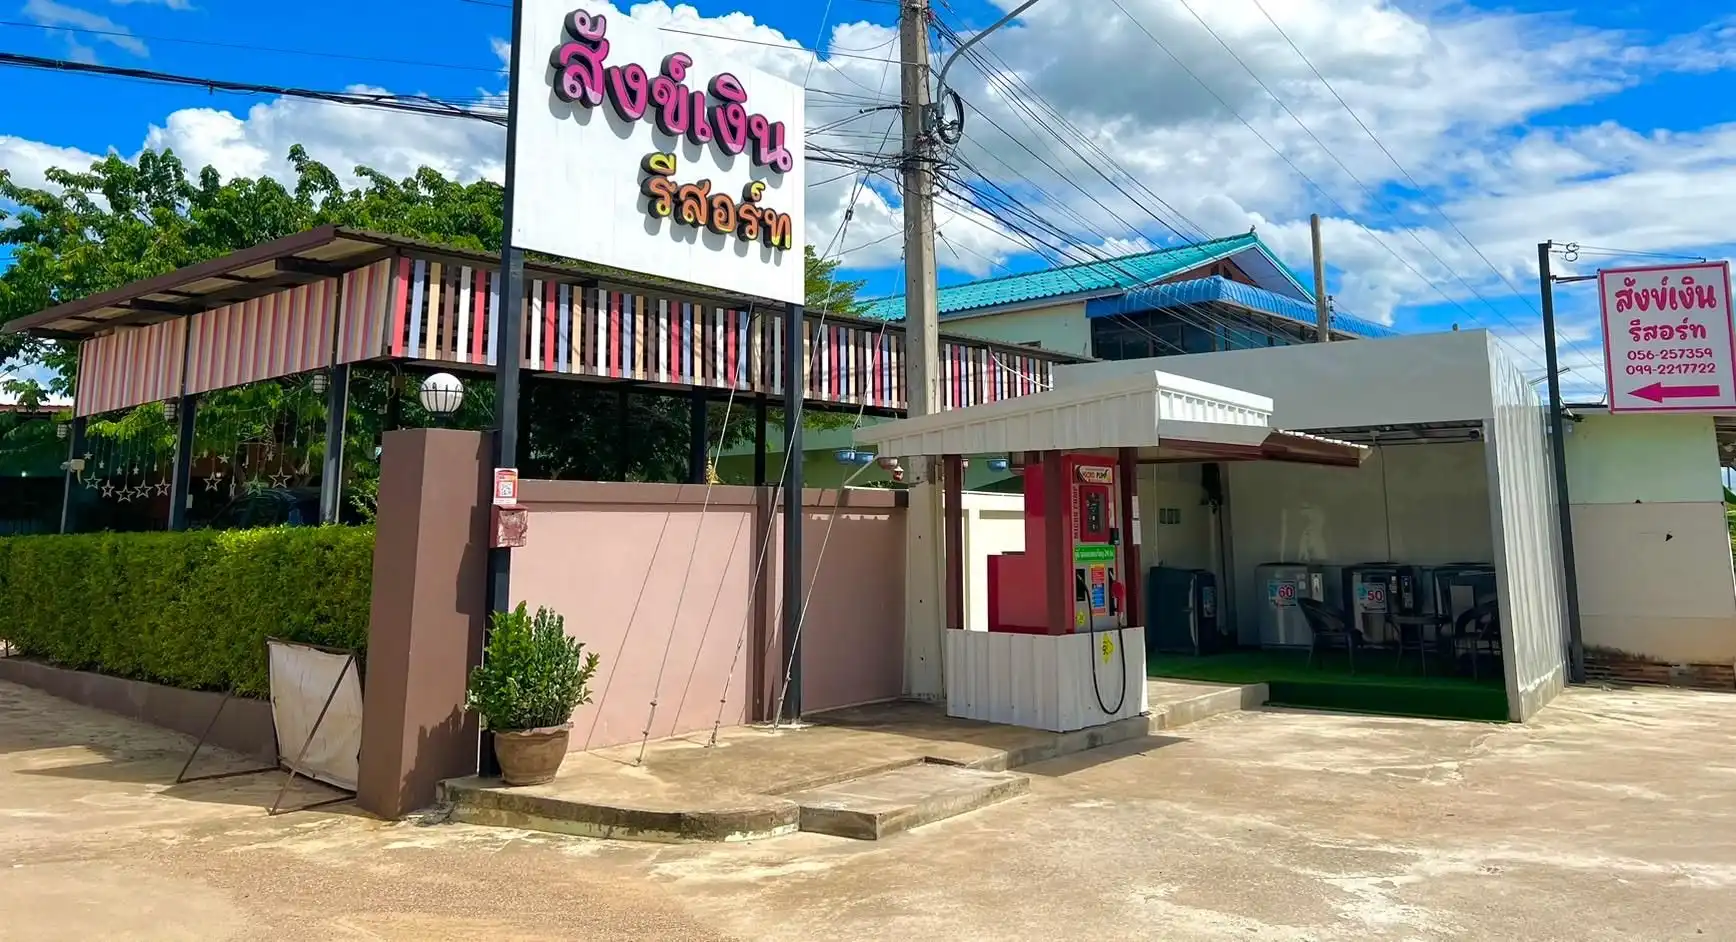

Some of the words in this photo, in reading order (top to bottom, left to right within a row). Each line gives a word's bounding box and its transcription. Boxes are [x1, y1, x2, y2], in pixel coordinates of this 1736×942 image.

[549, 9, 793, 173] สังข์เงิน
[641, 152, 792, 250] รีสอร์ท
[1615, 276, 1717, 313] สังข์เงิน
[1628, 317, 1707, 342] รีสอร์ท
[1627, 348, 1713, 361] 056-257359
[1626, 363, 1716, 375] 099-2217722
[1278, 586, 1295, 598] 60
[1367, 590, 1383, 601] 50
